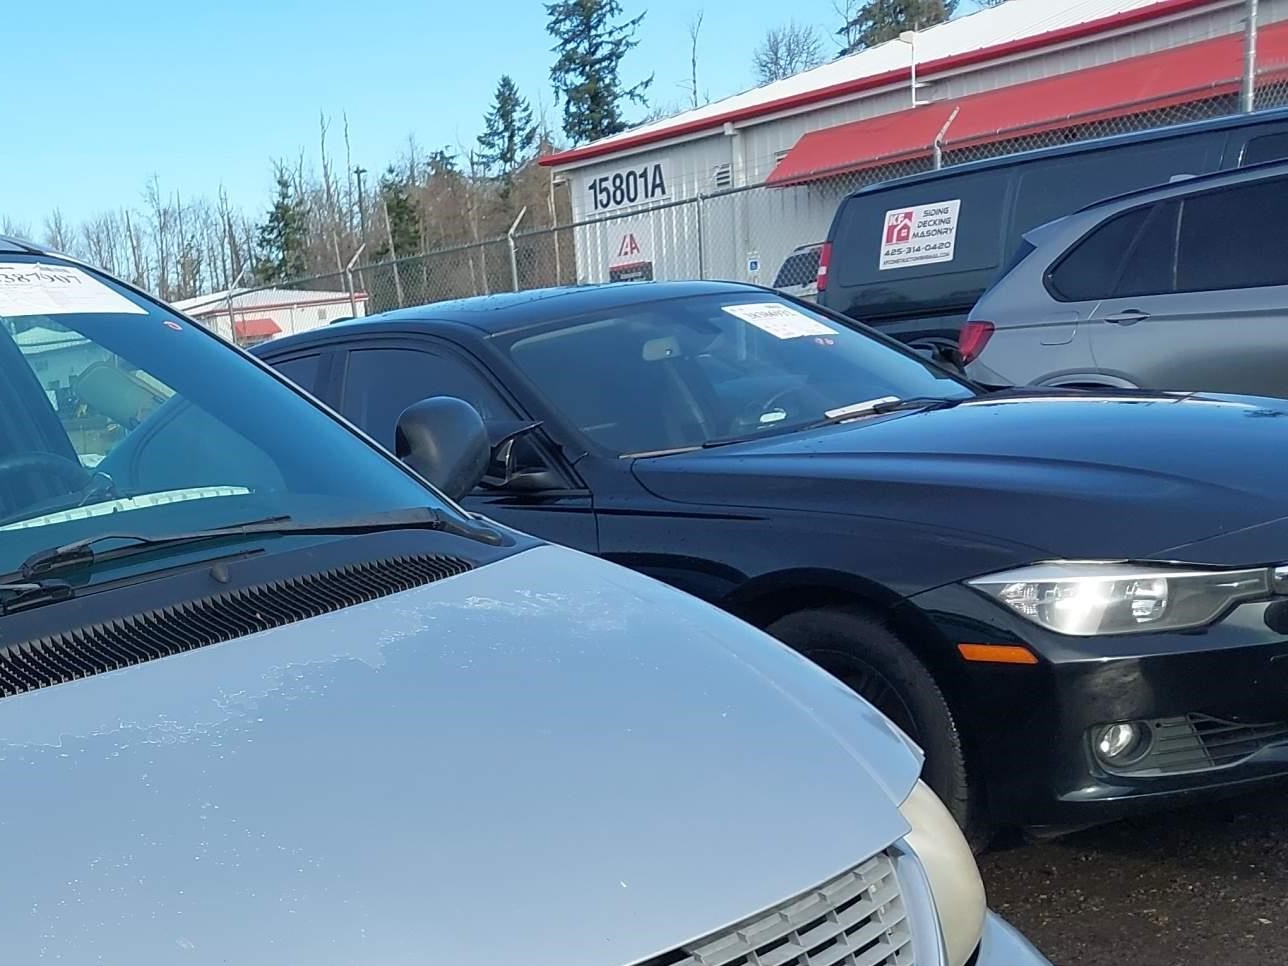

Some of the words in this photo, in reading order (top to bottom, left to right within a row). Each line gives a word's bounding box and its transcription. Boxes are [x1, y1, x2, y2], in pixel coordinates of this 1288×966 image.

[588, 163, 666, 210] 15801A
[923, 206, 950, 217] SIDING
[917, 217, 952, 228] DECKING
[912, 227, 954, 239] MASONRY
[884, 241, 952, 256] 425-314-0420
